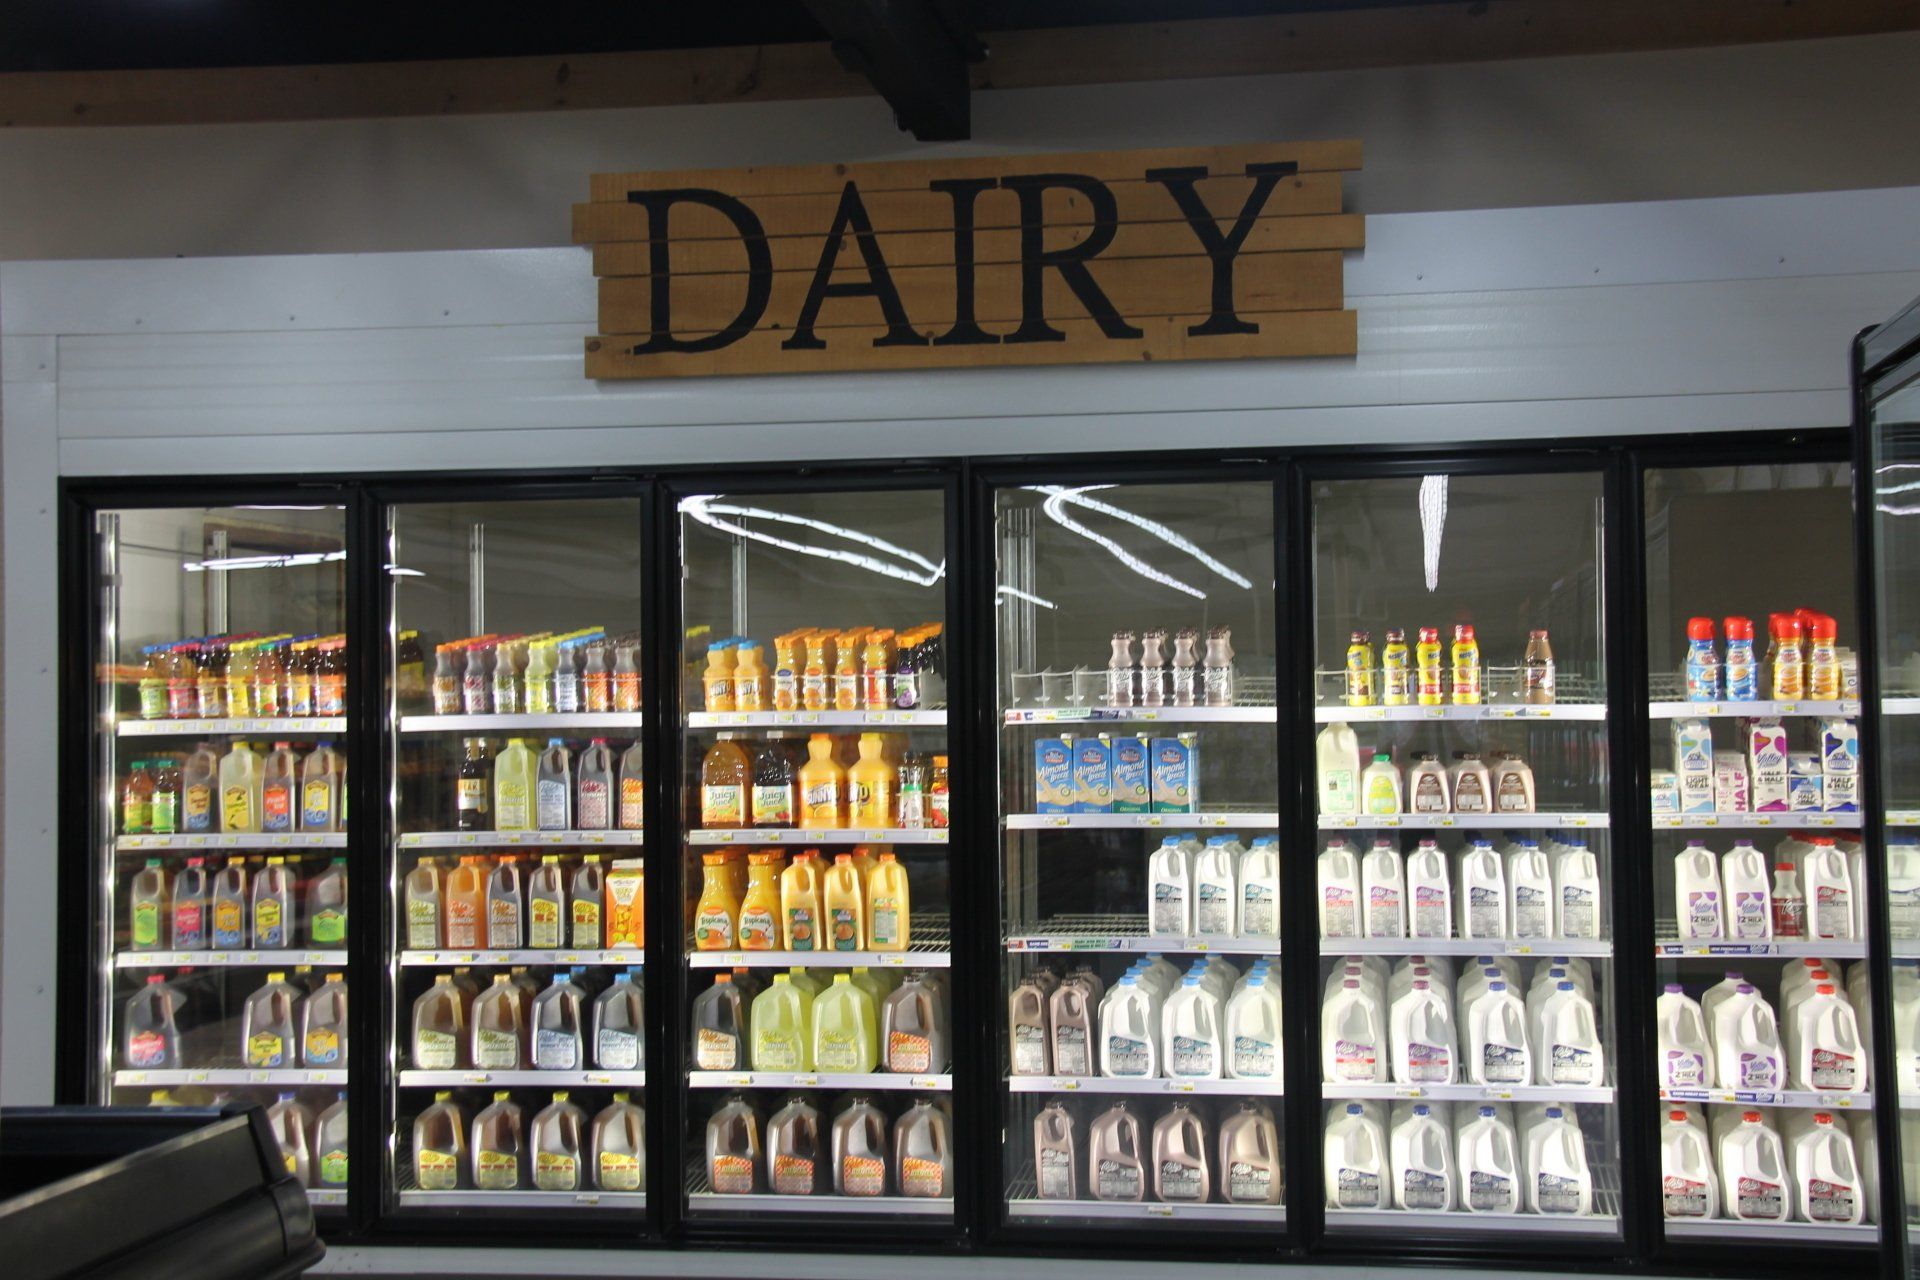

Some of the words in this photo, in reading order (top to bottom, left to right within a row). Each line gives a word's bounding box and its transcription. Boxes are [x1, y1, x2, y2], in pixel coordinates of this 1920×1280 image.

[627, 161, 1298, 355] DAIRY
[1039, 760, 1069, 778] Almond
[1076, 760, 1107, 778] Almond
[1114, 759, 1145, 777] Almond
[1155, 760, 1186, 779] Almond
[711, 791, 736, 800] Juicy
[761, 791, 786, 800] Juicy
[1734, 772, 1746, 812] HALF
[712, 799, 731, 807] Juice
[763, 799, 783, 807] Juice
[701, 917, 728, 925] Tropicana
[744, 917, 771, 925] Tropicana
